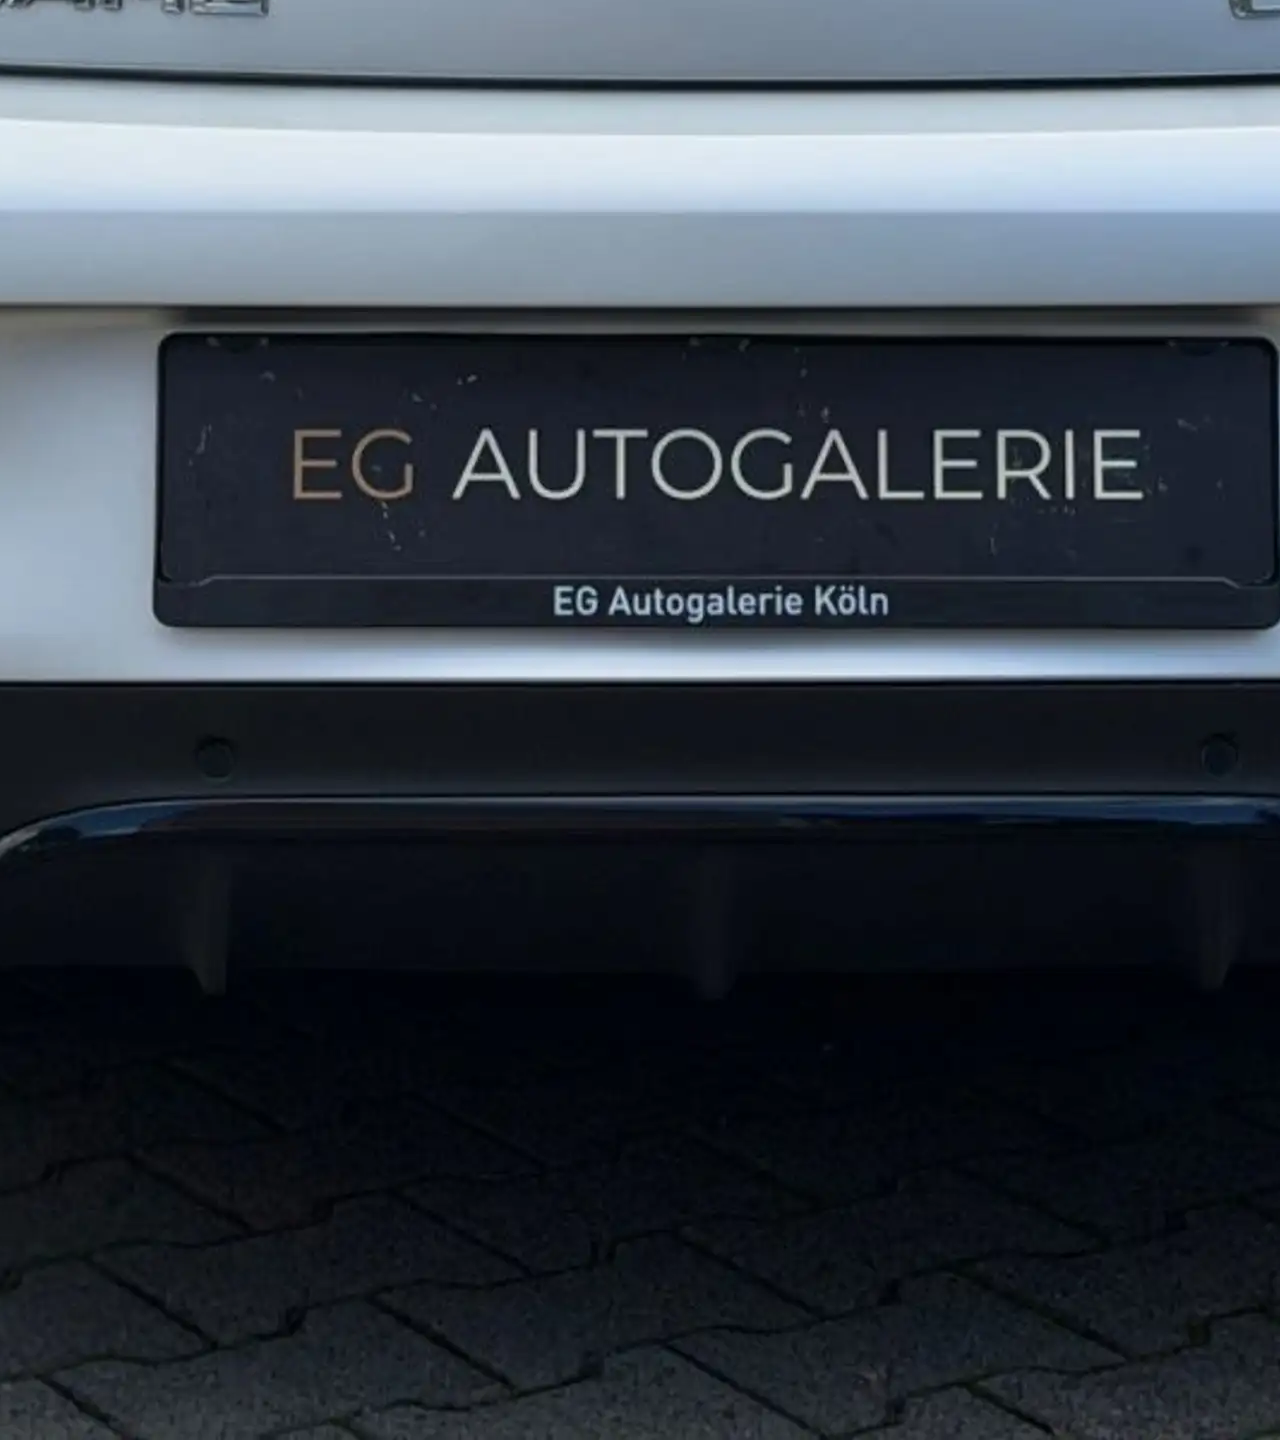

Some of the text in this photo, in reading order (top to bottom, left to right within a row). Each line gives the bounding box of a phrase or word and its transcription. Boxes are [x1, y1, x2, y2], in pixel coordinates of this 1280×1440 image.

[292, 428, 1144, 501] EG AUTOGALERIE
[553, 584, 889, 623] EG Autogalerie Köln
